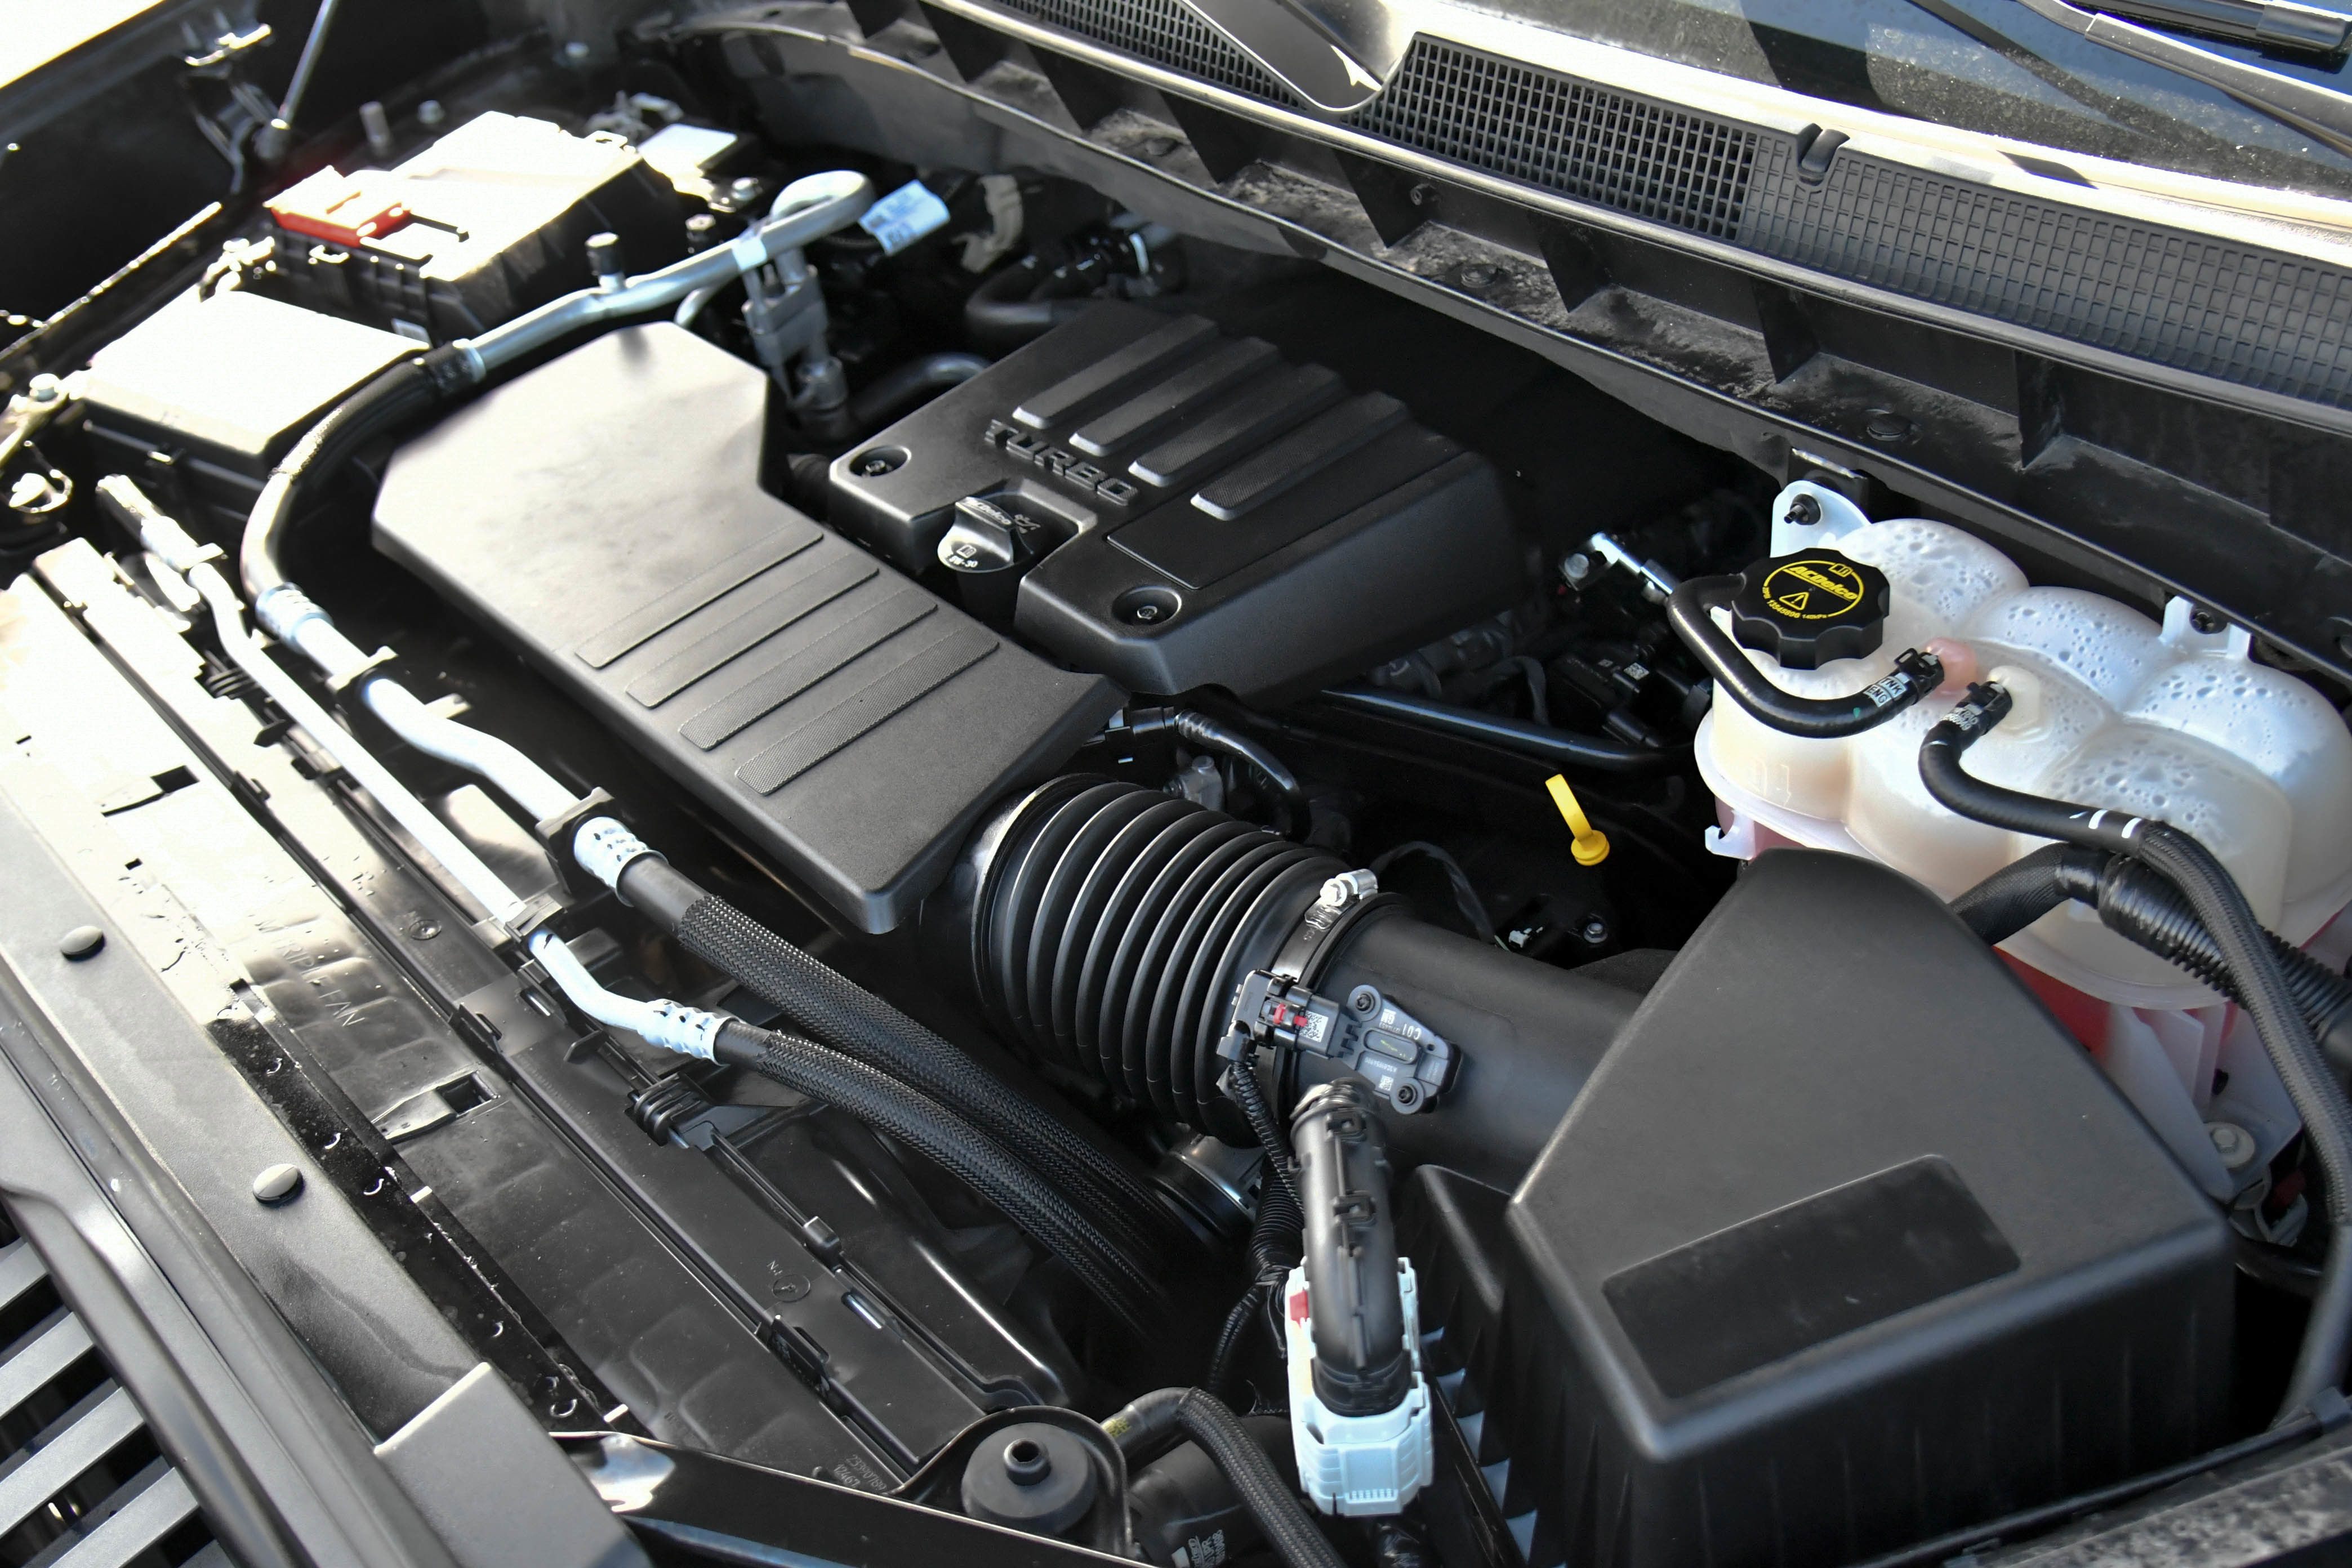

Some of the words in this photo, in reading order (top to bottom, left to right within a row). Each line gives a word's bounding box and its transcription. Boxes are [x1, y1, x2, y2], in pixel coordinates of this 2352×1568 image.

[984, 418, 1138, 506] TURBO
[1788, 565, 1858, 600] ACDelco
[1867, 686, 1888, 703] ENG
[1881, 678, 1903, 694] TNK
